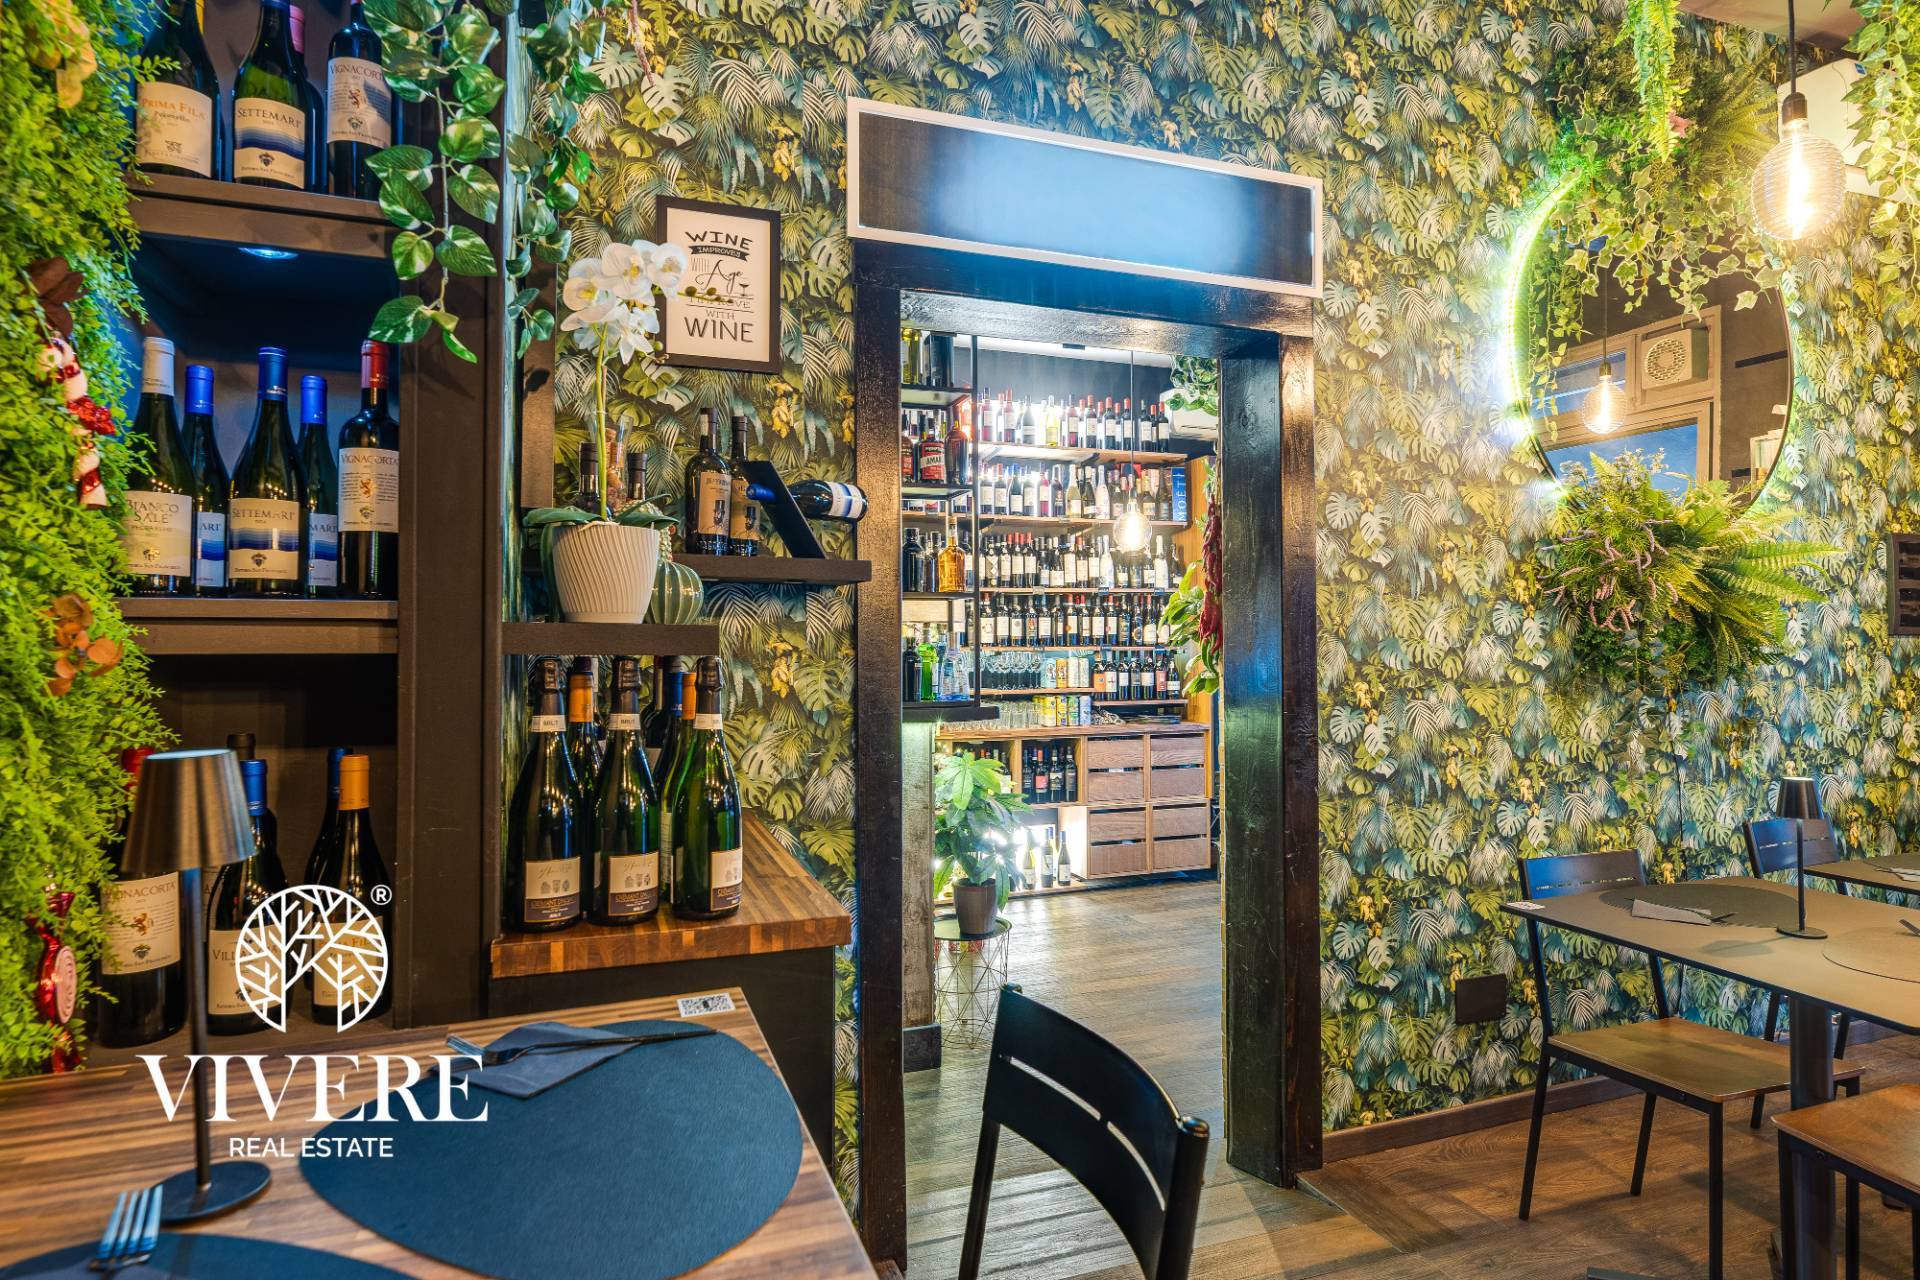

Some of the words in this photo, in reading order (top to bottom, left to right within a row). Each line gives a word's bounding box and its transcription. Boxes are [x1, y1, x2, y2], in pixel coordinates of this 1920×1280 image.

[142, 98, 176, 110] PRIMA
[179, 102, 206, 120] FILA
[685, 231, 753, 250] WINE
[697, 246, 741, 258] IMPROVES
[690, 257, 710, 273] WITH
[695, 259, 743, 294] Age
[706, 309, 735, 320] WITH
[684, 316, 753, 343] WINE
[134, 511, 169, 524] SALE
